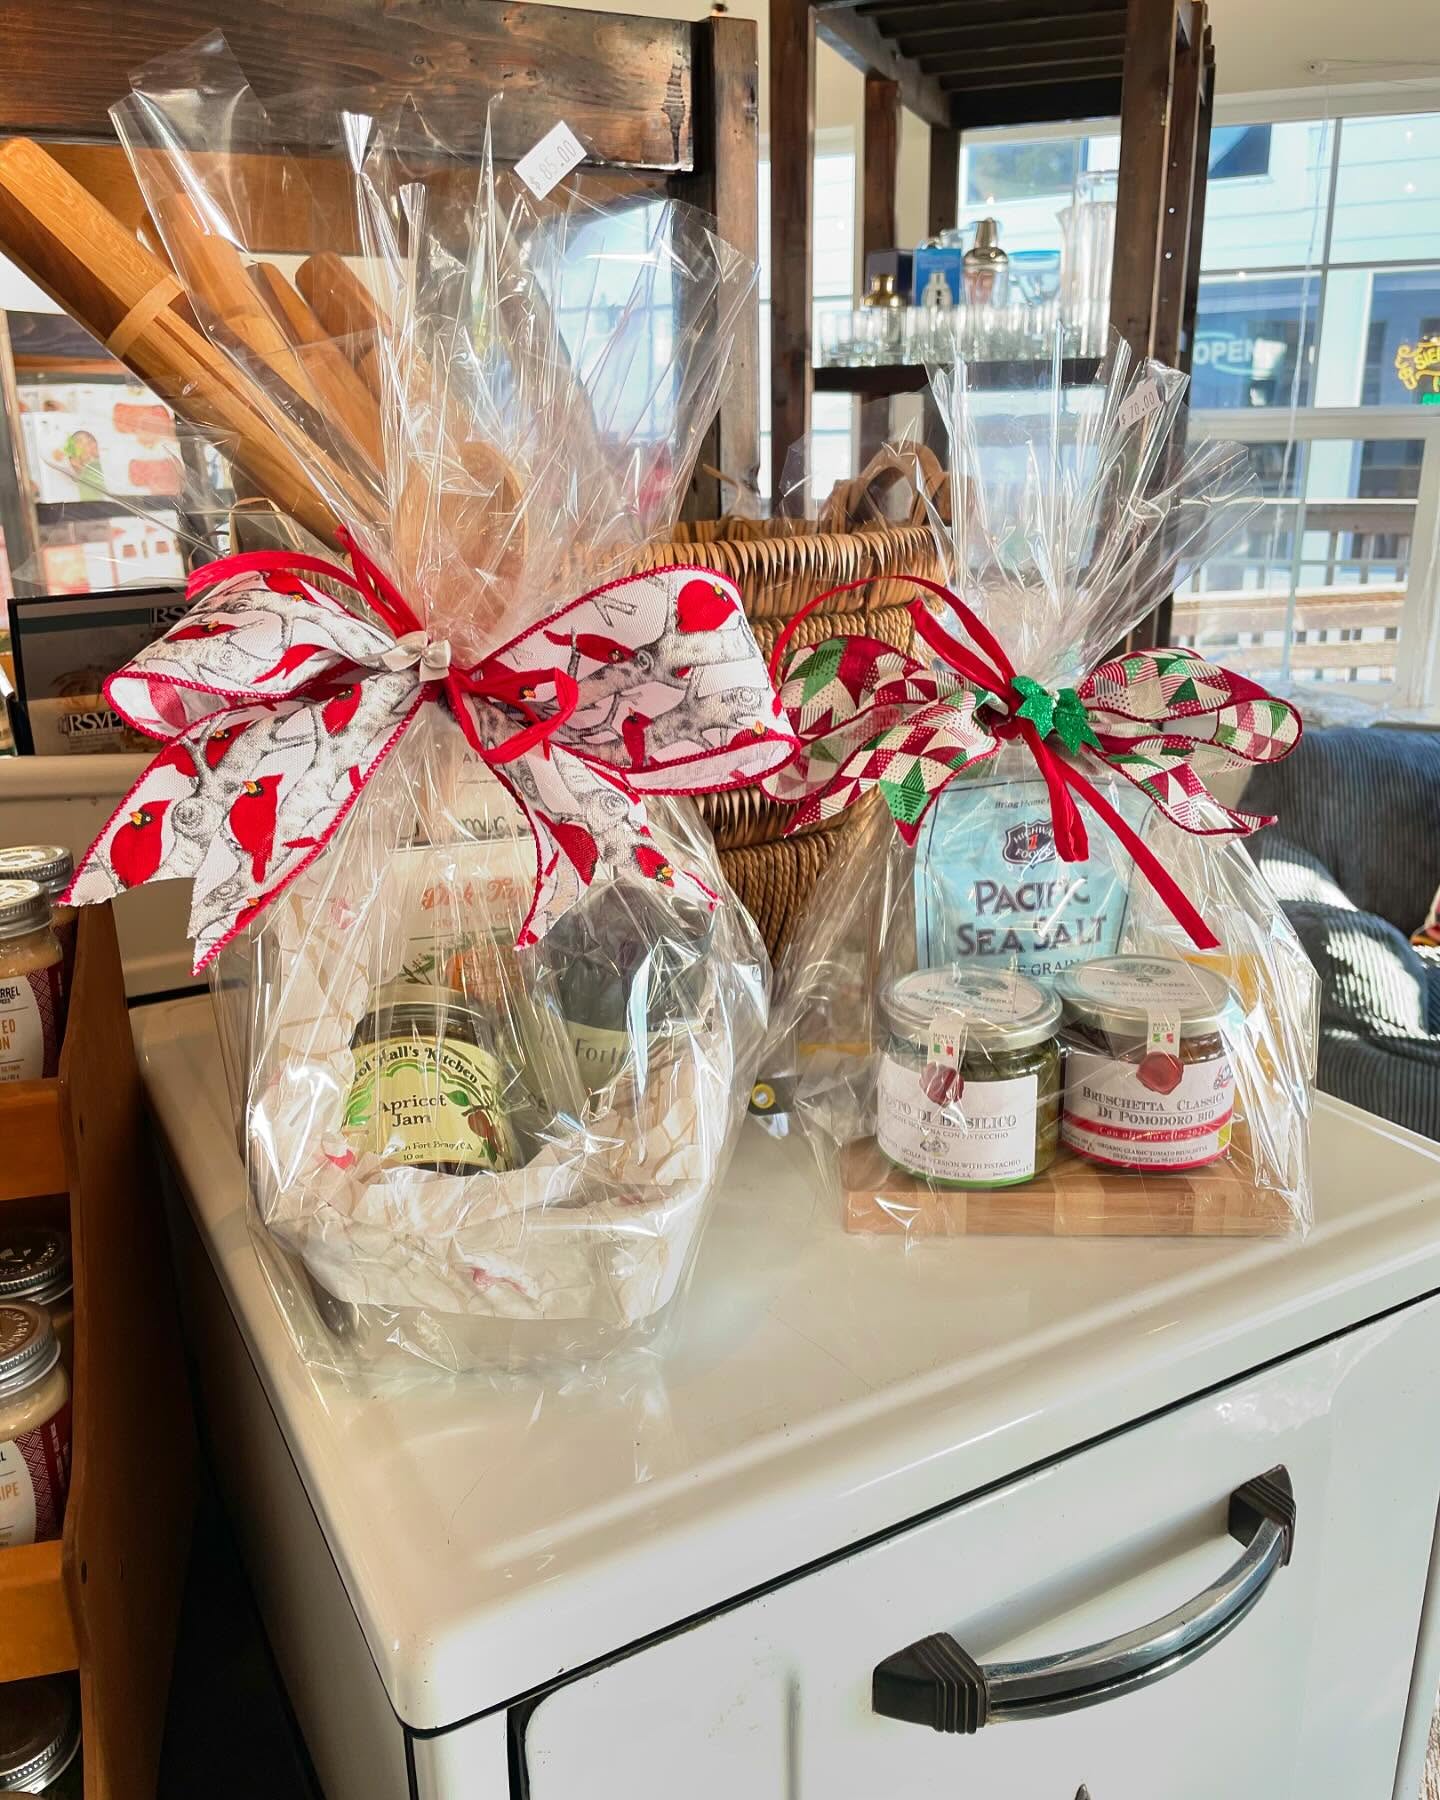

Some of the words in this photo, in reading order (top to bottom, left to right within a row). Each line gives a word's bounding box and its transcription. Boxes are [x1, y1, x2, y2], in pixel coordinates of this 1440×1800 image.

[69, 711, 120, 734] RSVP
[957, 922, 1026, 956] SEA
[1033, 914, 1107, 951] SALT
[424, 1046, 479, 1085] Ktchen
[380, 1094, 447, 1116] Apricot
[1082, 1086, 1165, 1112] BRUSCHETTA
[1176, 1092, 1225, 1111] CLASSICA
[391, 1111, 432, 1128] Jam
[1098, 1107, 1112, 1119] DI
[1119, 1111, 1193, 1126] POMODORO
[1197, 1108, 1214, 1121] BIO
